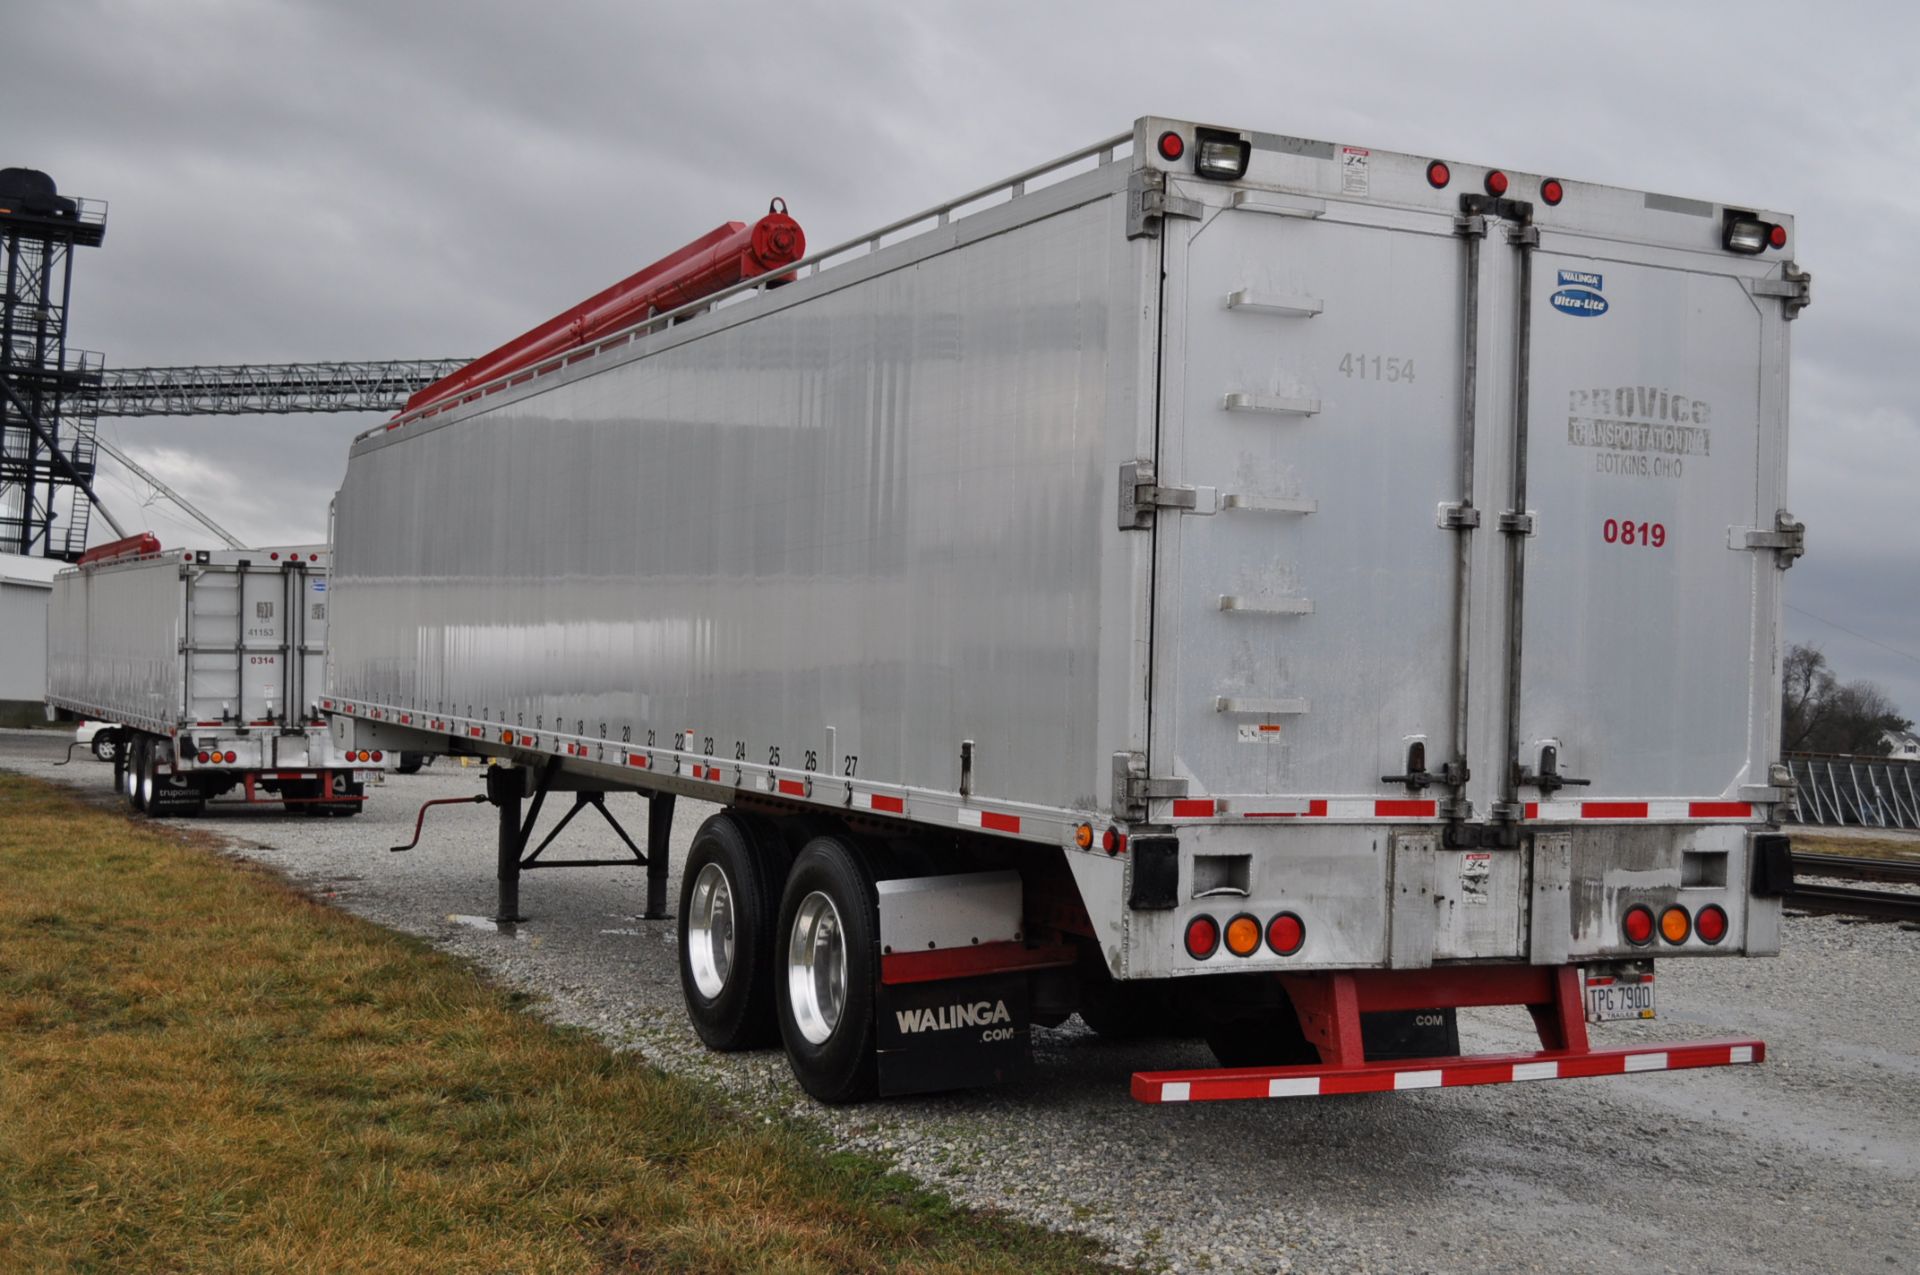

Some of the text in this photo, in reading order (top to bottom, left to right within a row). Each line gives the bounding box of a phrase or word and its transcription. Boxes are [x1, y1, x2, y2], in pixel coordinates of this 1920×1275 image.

[1562, 271, 1600, 284] WALINGA
[1554, 295, 1605, 311] Ultra-Lite
[1338, 352, 1416, 384] 41154
[1571, 422, 1682, 453] TRANSPORTATION
[1653, 457, 1683, 479] OHIO
[1603, 518, 1666, 548] 0819
[250, 656, 275, 665] 0314
[622, 725, 631, 743] 20
[647, 729, 656, 748] 21
[675, 733, 685, 751] 22
[704, 737, 714, 756] 23
[735, 740, 746, 761] 24
[768, 745, 780, 767] 25
[805, 749, 817, 772] 26
[844, 754, 858, 777] 27
[1589, 988, 1614, 1012] TPG
[895, 1000, 1011, 1034] WALINGA
